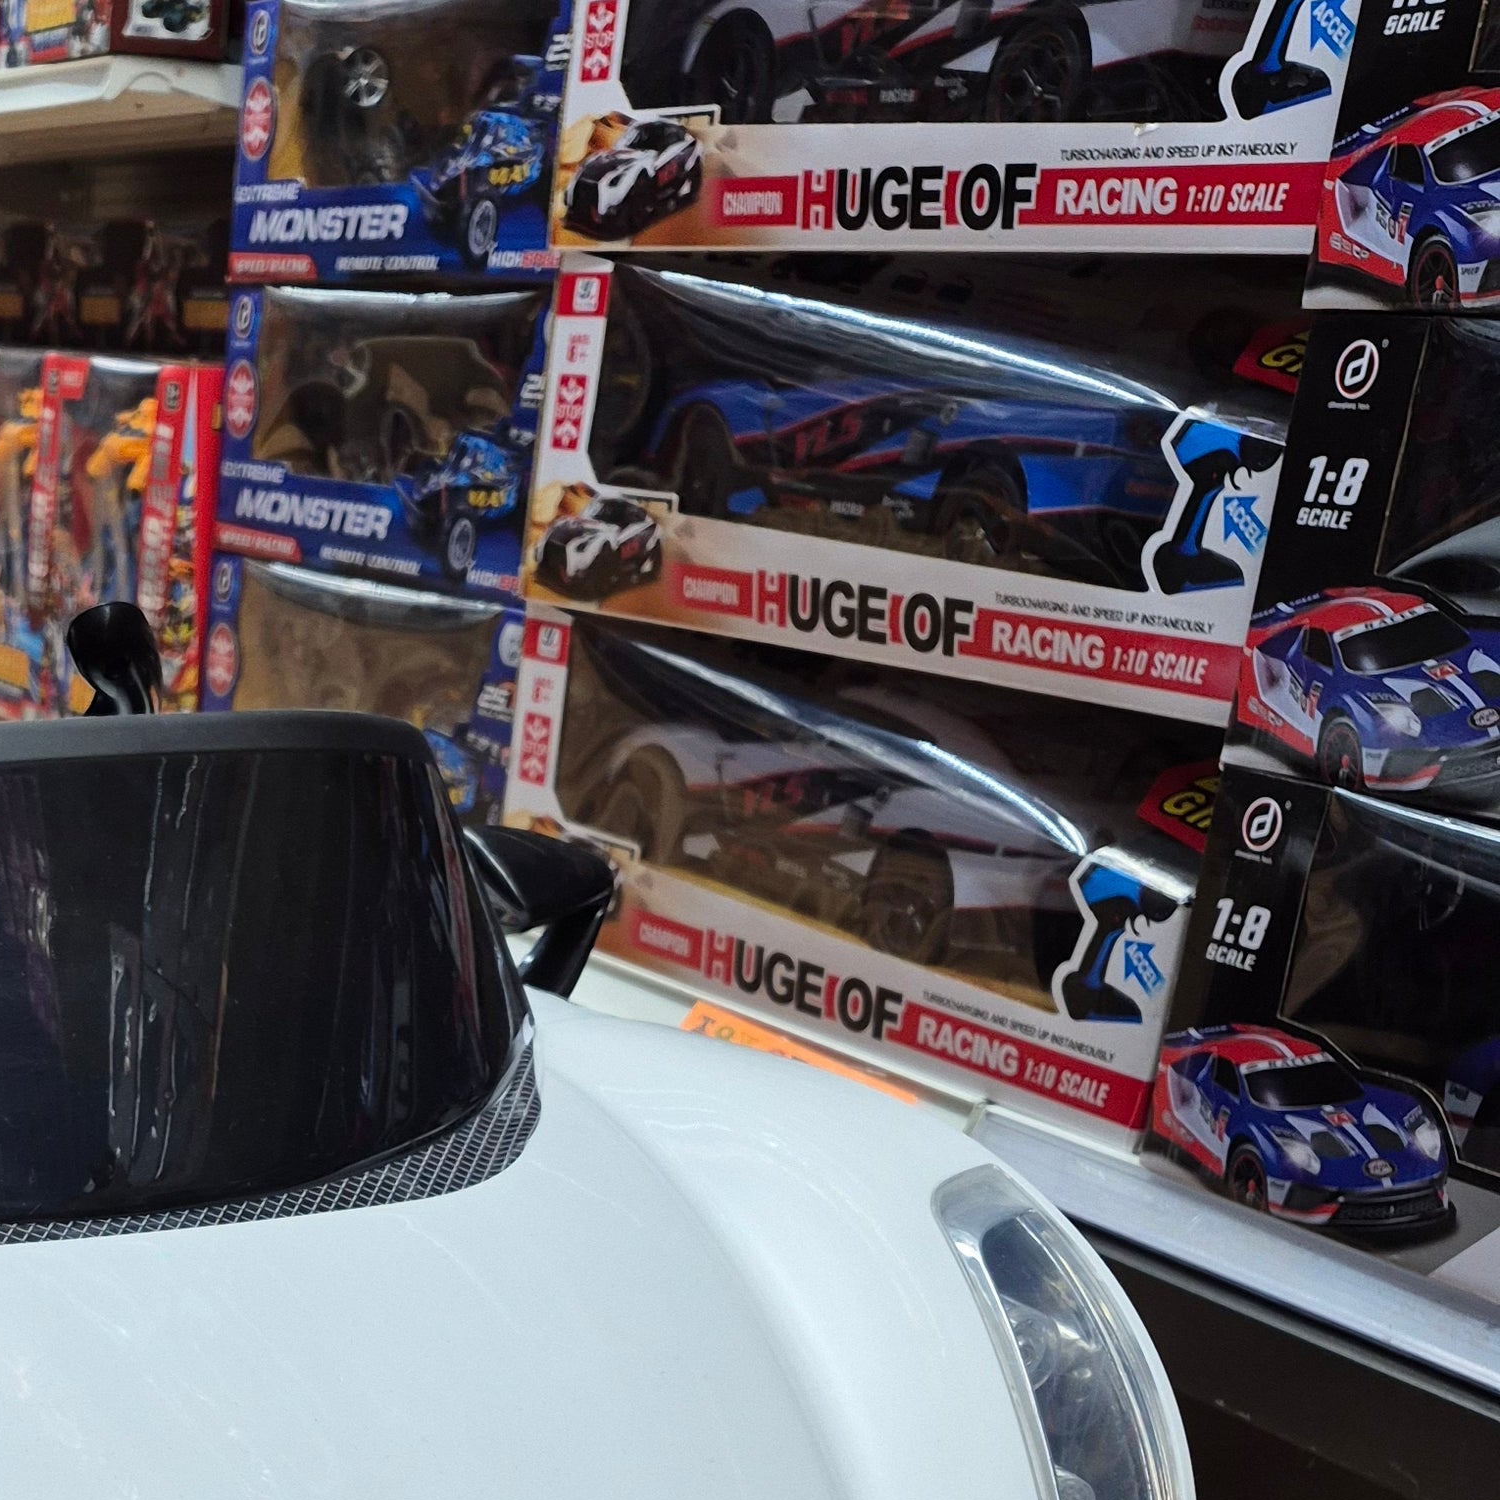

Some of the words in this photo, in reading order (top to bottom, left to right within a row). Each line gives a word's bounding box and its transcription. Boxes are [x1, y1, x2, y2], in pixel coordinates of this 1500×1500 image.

[1383, 9, 1445, 36] SCALE
[1143, 148, 1164, 160] AND
[1166, 145, 1200, 159] SPEED
[1201, 145, 1216, 157] UP
[722, 191, 784, 216] CHAMPION
[1055, 177, 1178, 216] RACING
[1185, 184, 1224, 213] 1:10
[1227, 182, 1290, 213] SCALE
[249, 204, 408, 244] MONSTER
[1303, 455, 1370, 506] 1:8
[235, 487, 393, 541] MONSTER
[1296, 507, 1353, 530] SCALE
[682, 575, 740, 606] CHAMPION
[991, 619, 1105, 670] RACING
[1111, 646, 1148, 675] 1:10
[1151, 651, 1208, 685] SCALE
[1211, 898, 1271, 951] 1:8
[1205, 942, 1258, 972] SCALE
[916, 1014, 1020, 1077] RACING
[1023, 1057, 1058, 1090] 1:10
[1057, 1068, 1111, 1108] SCALE
